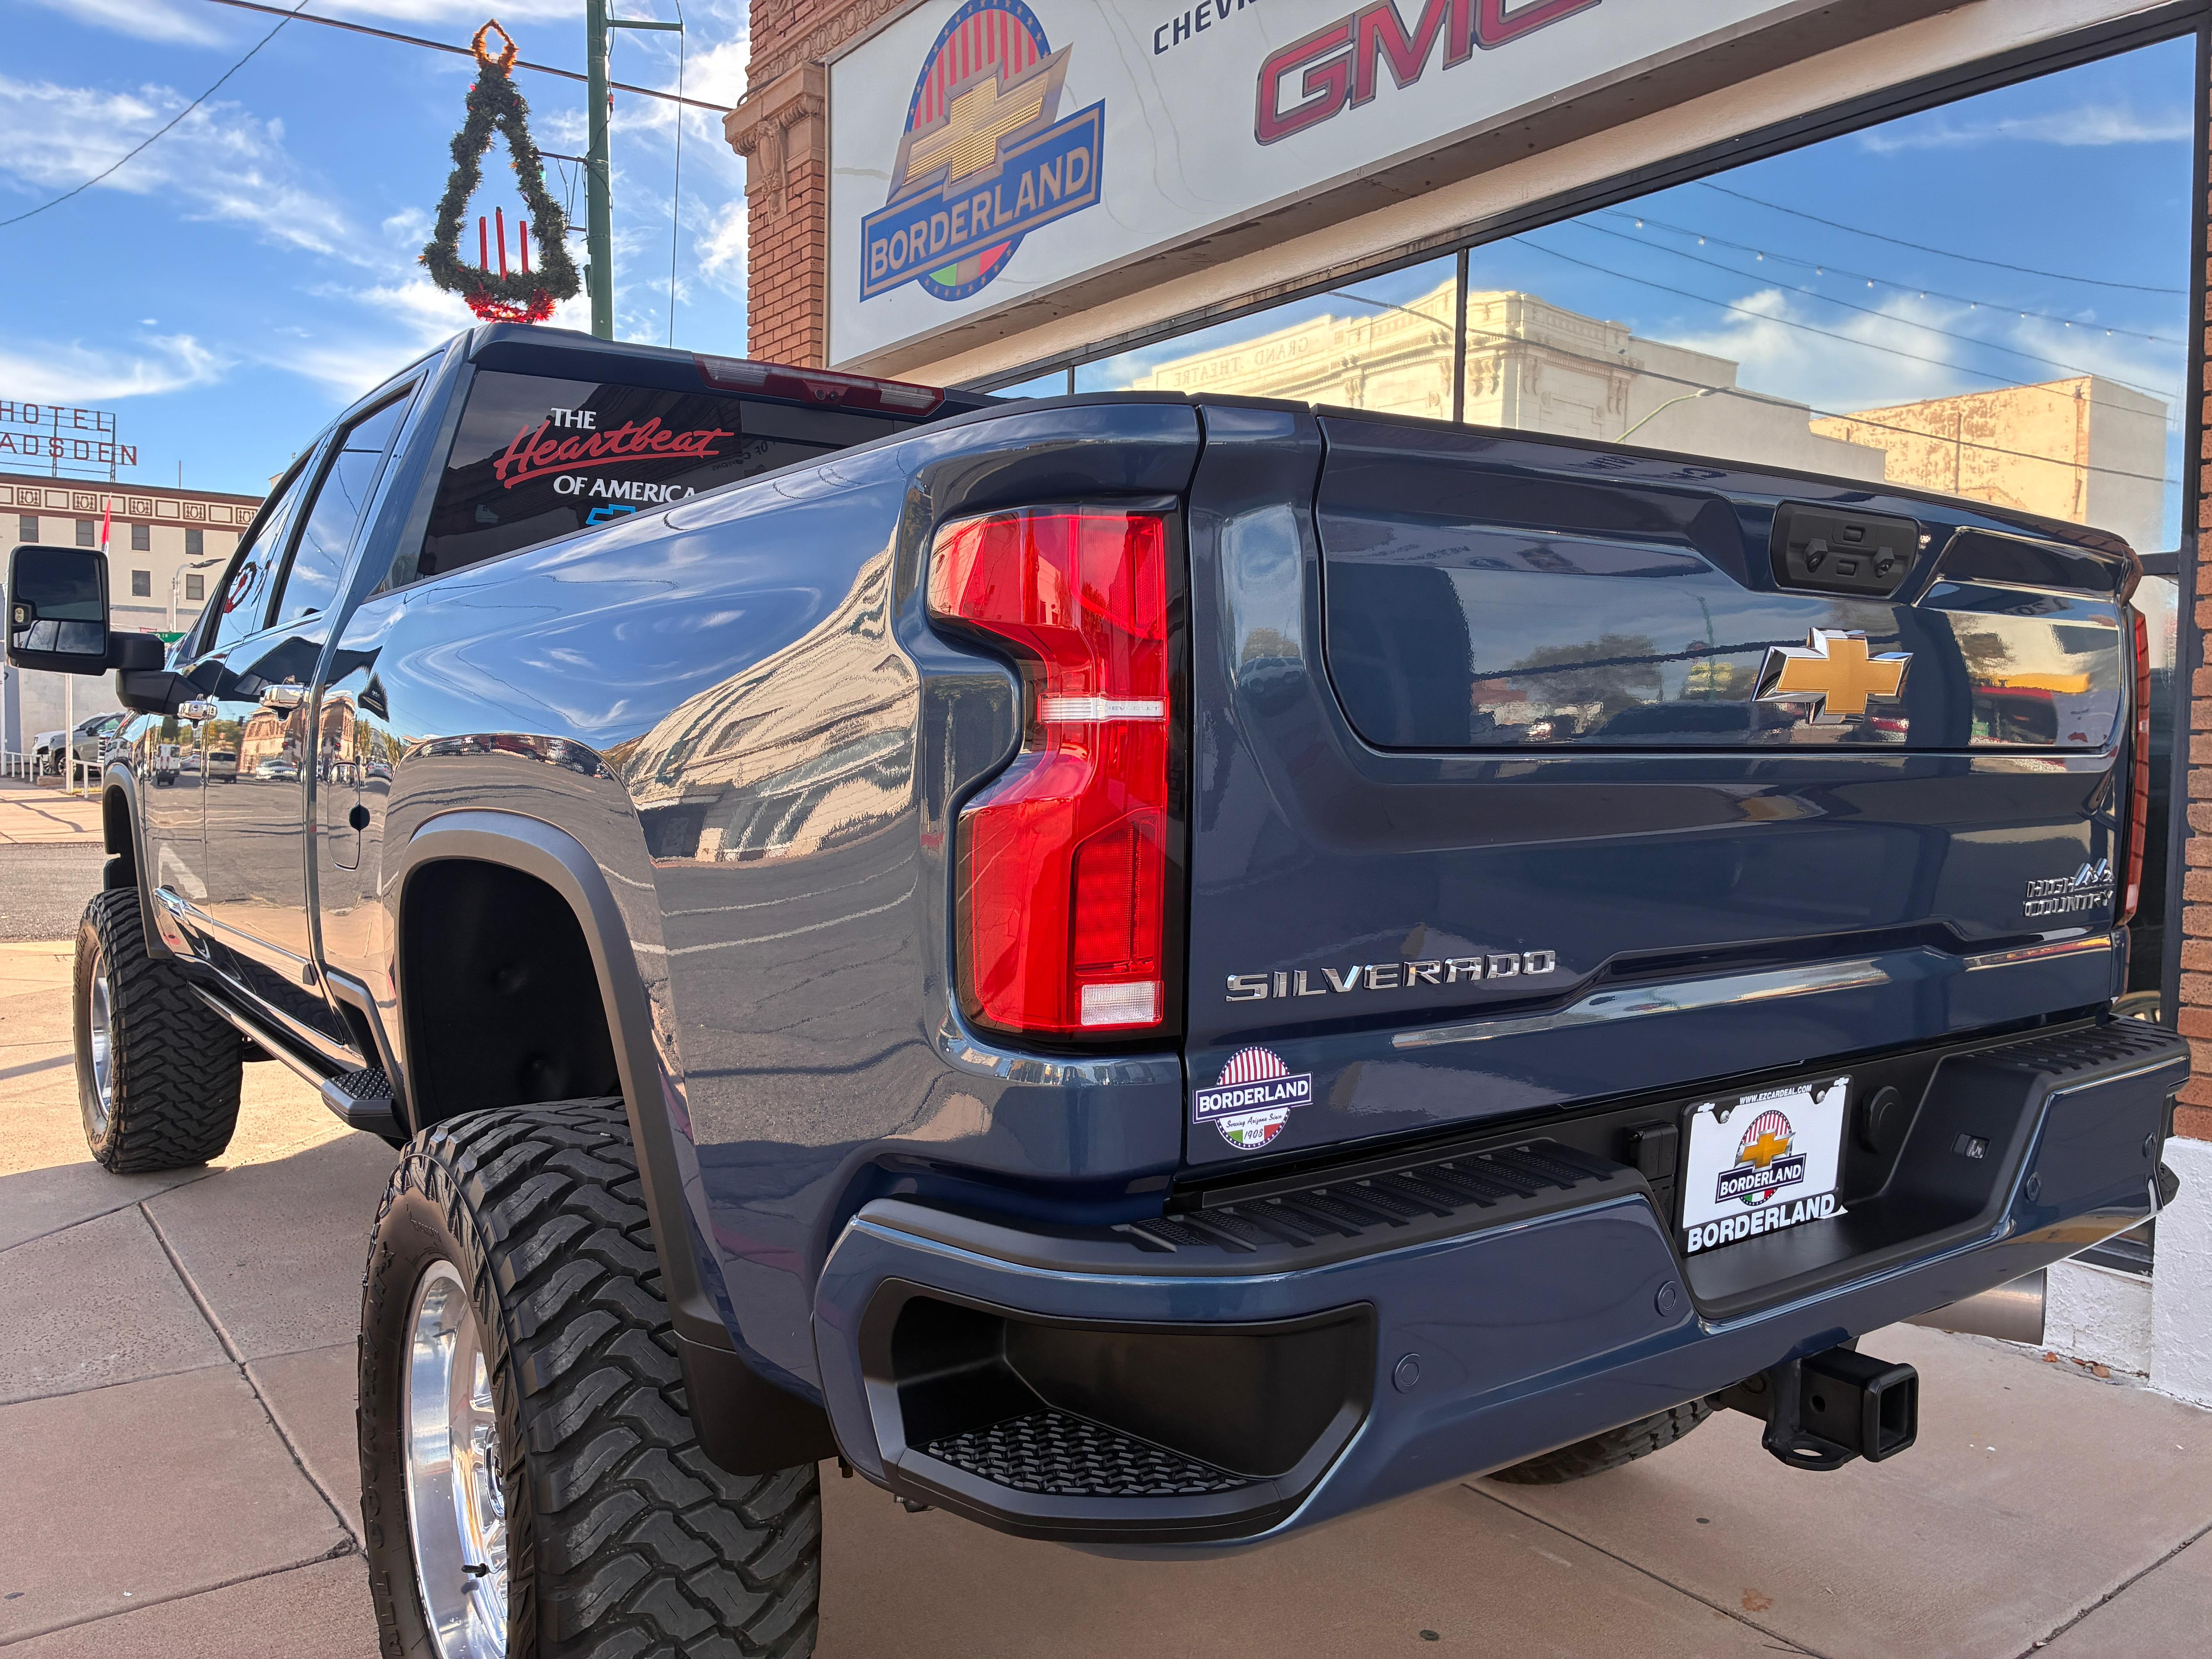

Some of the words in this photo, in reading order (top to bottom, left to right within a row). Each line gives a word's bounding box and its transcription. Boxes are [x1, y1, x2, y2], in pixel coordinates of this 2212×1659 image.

[871, 146, 1090, 280] BORDERLAND
[0, 400, 111, 432] HOTEL
[550, 407, 596, 430] THE
[493, 417, 734, 480] Heartbeat
[553, 475, 588, 495] OF
[2027, 876, 2076, 898] HIGH
[2024, 890, 2114, 917] COUNTRY
[1225, 950, 1556, 1002] SILVERADO
[1199, 1080, 1308, 1112] BORDERLAND
[1739, 1084, 1812, 1105] WWW.EZCARDEAL.COM
[1226, 1120, 1246, 1128] Serving
[1247, 1116, 1268, 1125] Arizona
[1244, 1128, 1263, 1140] 1908
[1720, 1164, 1802, 1196] BORDERLAND
[1688, 1194, 1835, 1253] BORDERLAND
